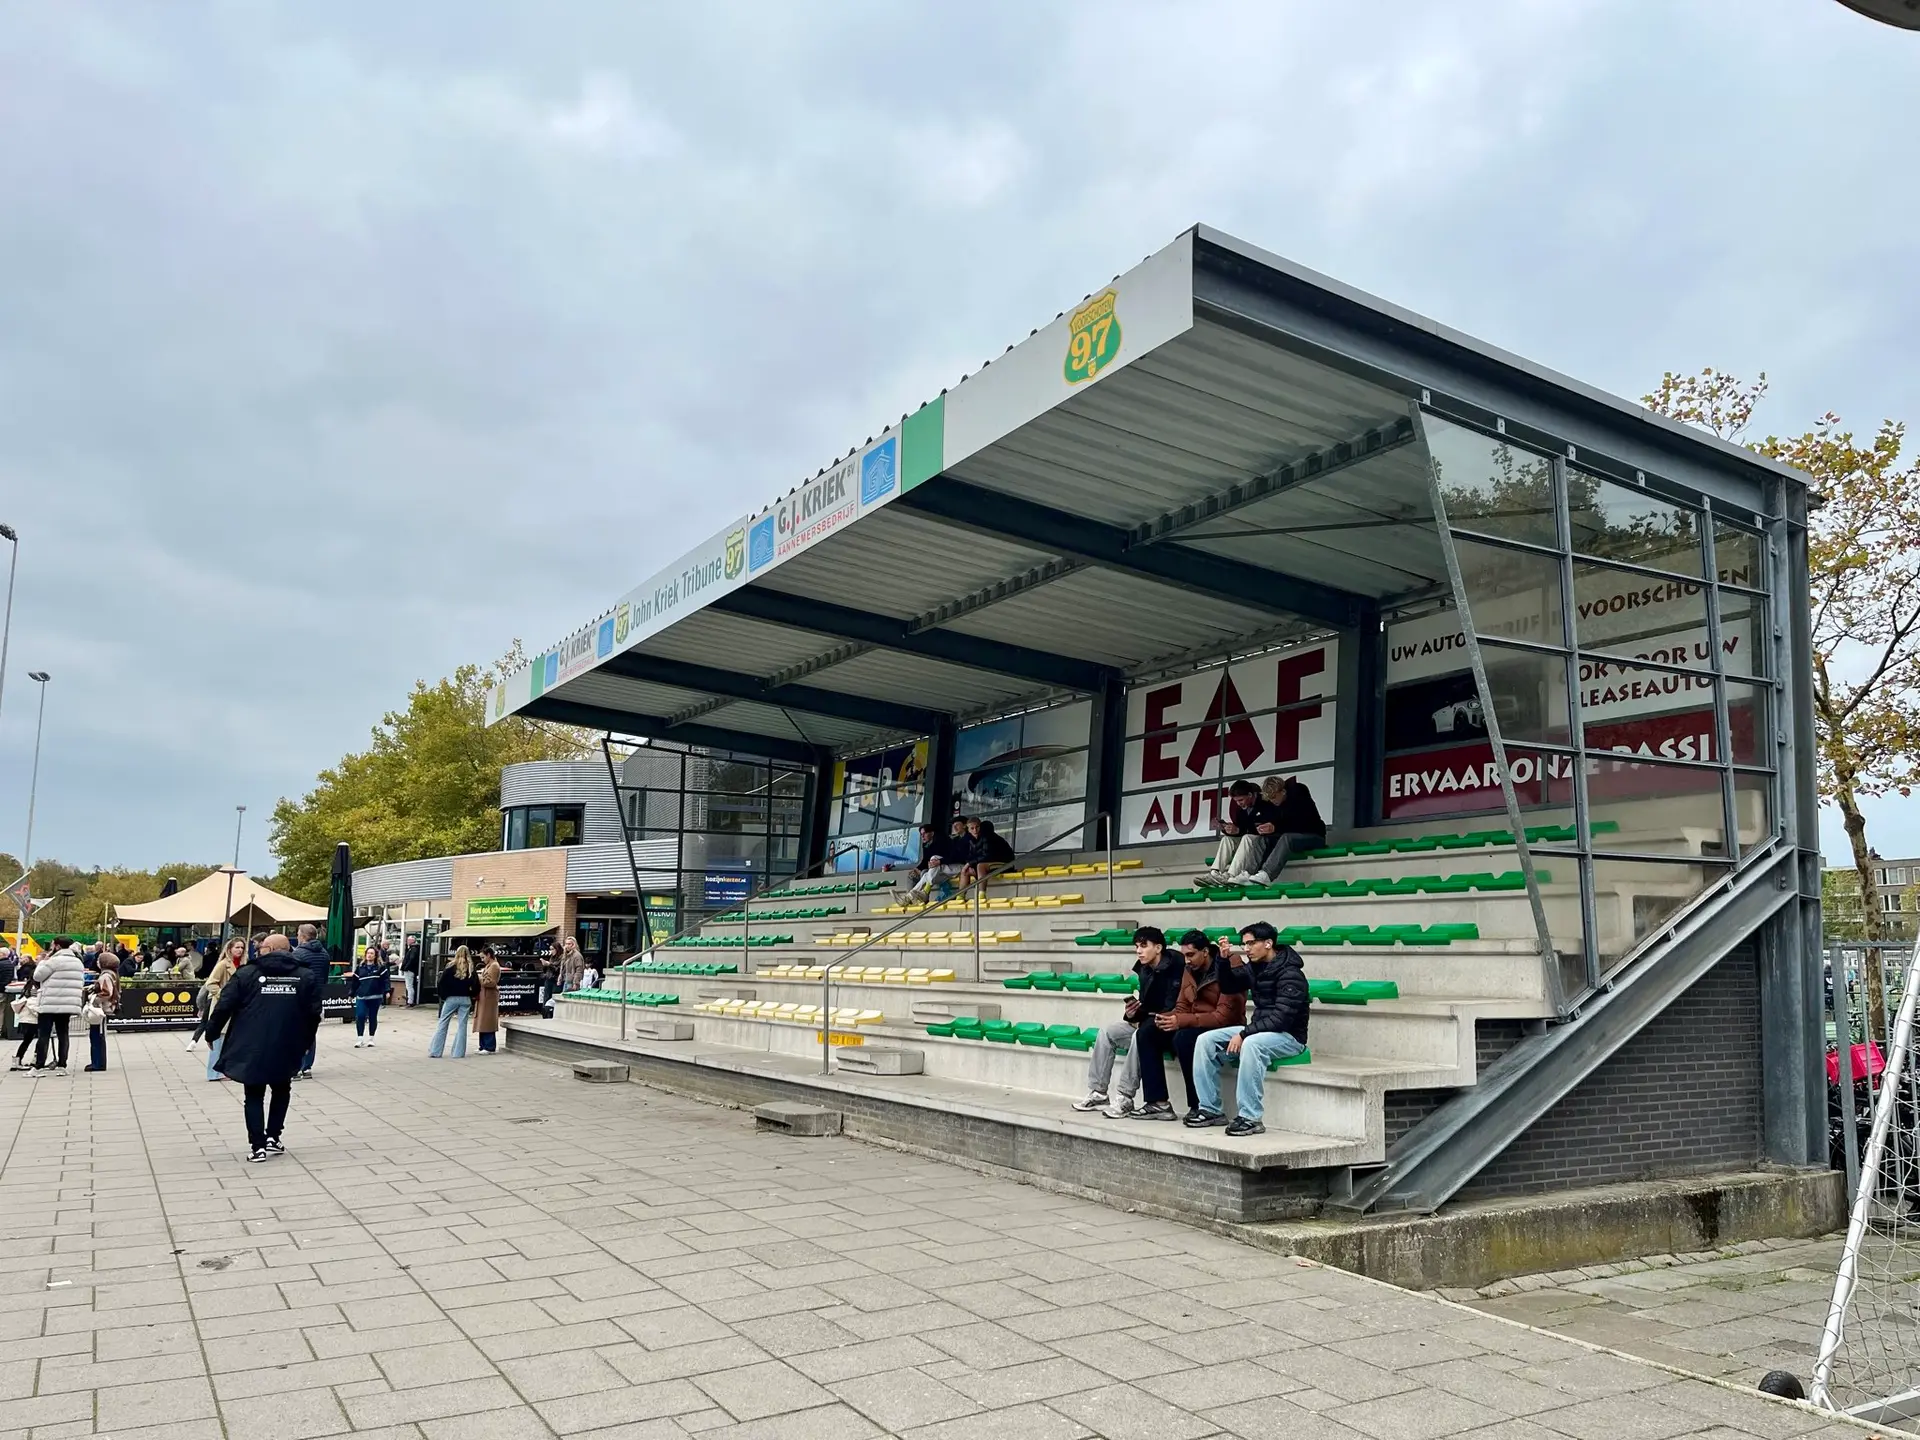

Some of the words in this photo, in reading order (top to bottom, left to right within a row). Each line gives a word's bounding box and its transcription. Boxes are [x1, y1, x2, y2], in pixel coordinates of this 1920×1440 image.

[1071, 314, 1113, 371] 97
[777, 500, 800, 536] G.J.
[802, 467, 846, 521] KRIEK
[777, 503, 855, 557] AANNEMERSBEDRIJF
[725, 543, 743, 575] 97
[630, 599, 652, 631] John
[654, 578, 679, 617] Kriek
[682, 556, 722, 600] Tribune
[1391, 643, 1417, 662] UW
[1577, 564, 1749, 620] VOORSCHOEN
[571, 631, 592, 662] KRIEK
[1142, 647, 1325, 779] EAF
[1389, 764, 1501, 798] ERVAAR
[883, 834, 908, 848] Advice
[141, 1005, 160, 1014] VERSE
[160, 1004, 194, 1013] POFFERTJES
[322, 997, 357, 1005] nderhoud
